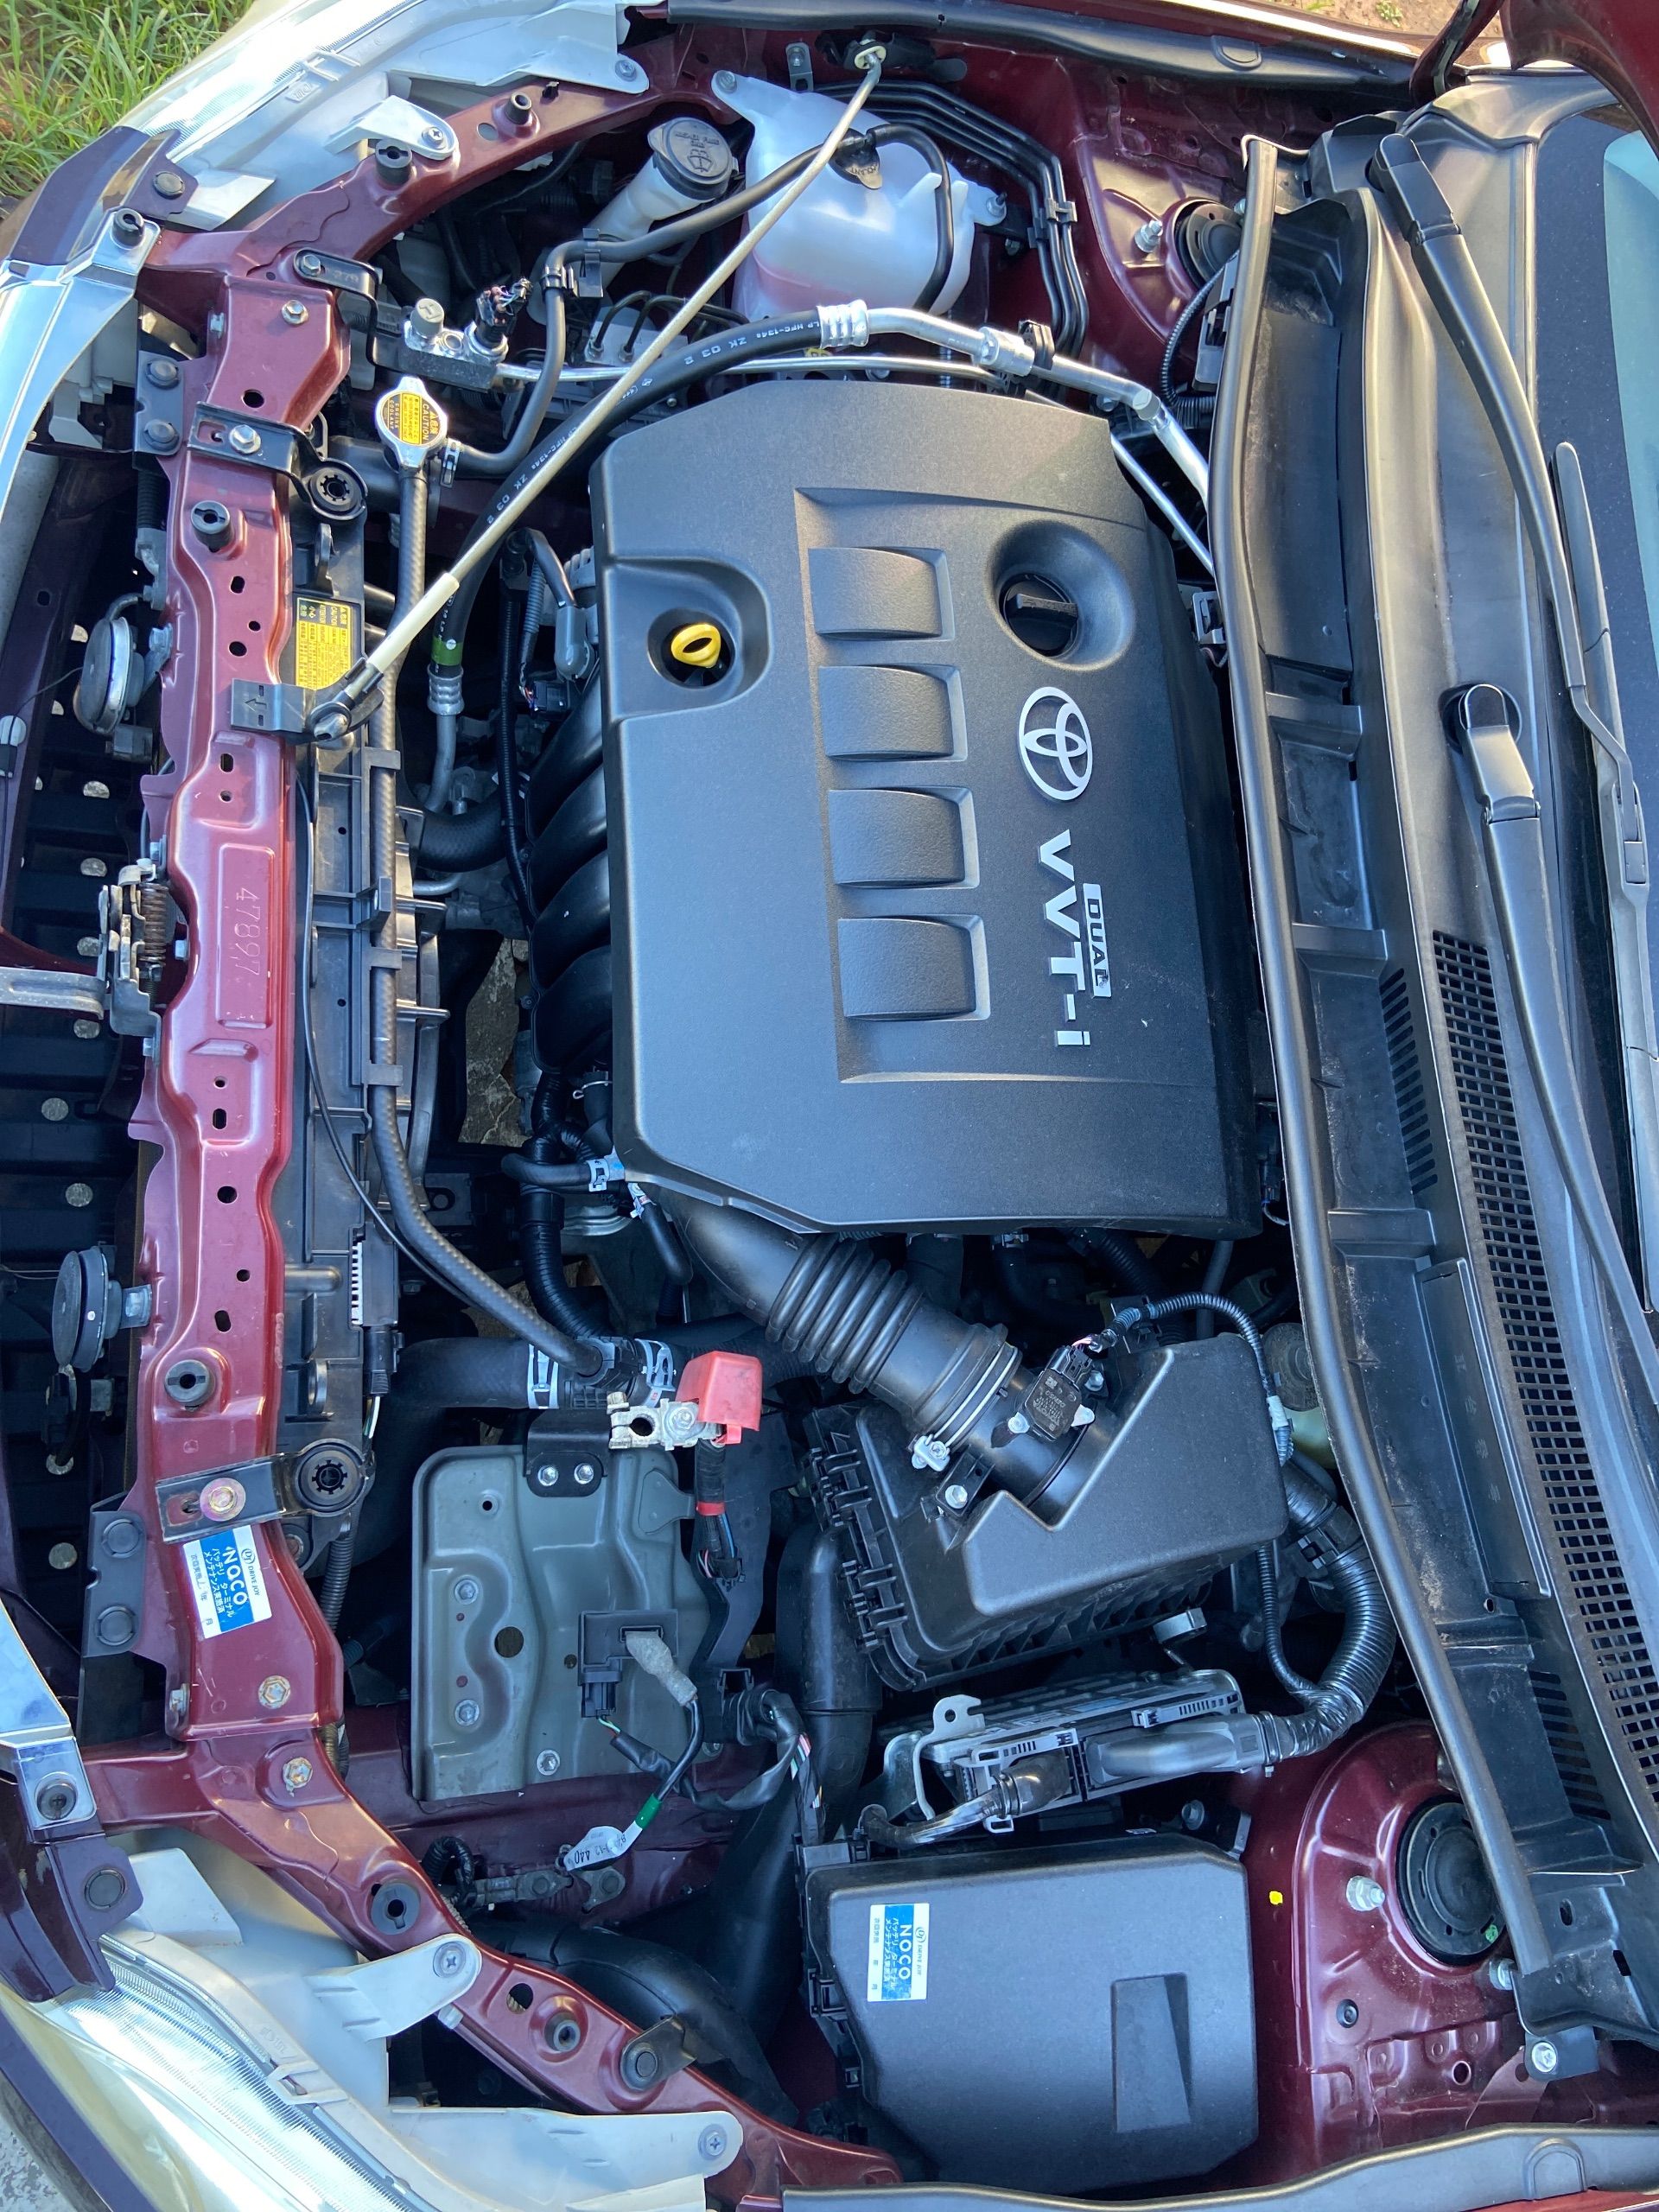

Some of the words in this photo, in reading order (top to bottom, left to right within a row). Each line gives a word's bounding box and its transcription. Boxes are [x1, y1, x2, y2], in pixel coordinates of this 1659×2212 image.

[728, 337, 747, 348] ZK
[757, 325, 804, 339] HFC-134a
[702, 346, 721, 358] 03
[514, 474, 528, 490] ZK
[234, 887, 261, 976] 47897
[1039, 829, 1090, 1046] VVT-i
[1087, 898, 1109, 987] DUAL
[204, 1552, 225, 1614] メンテナンス実施済
[212, 1548, 225, 1576] バッテリ
[219, 1582, 235, 1618] ターミナル
[222, 1548, 249, 1605] NOCO
[248, 1566, 257, 1584] DRIVE
[206, 1618, 213, 1626] 月
[574, 1850, 591, 1865] 440
[899, 1924, 912, 1980] NOCO
[890, 1953, 899, 1989] ターミナル
